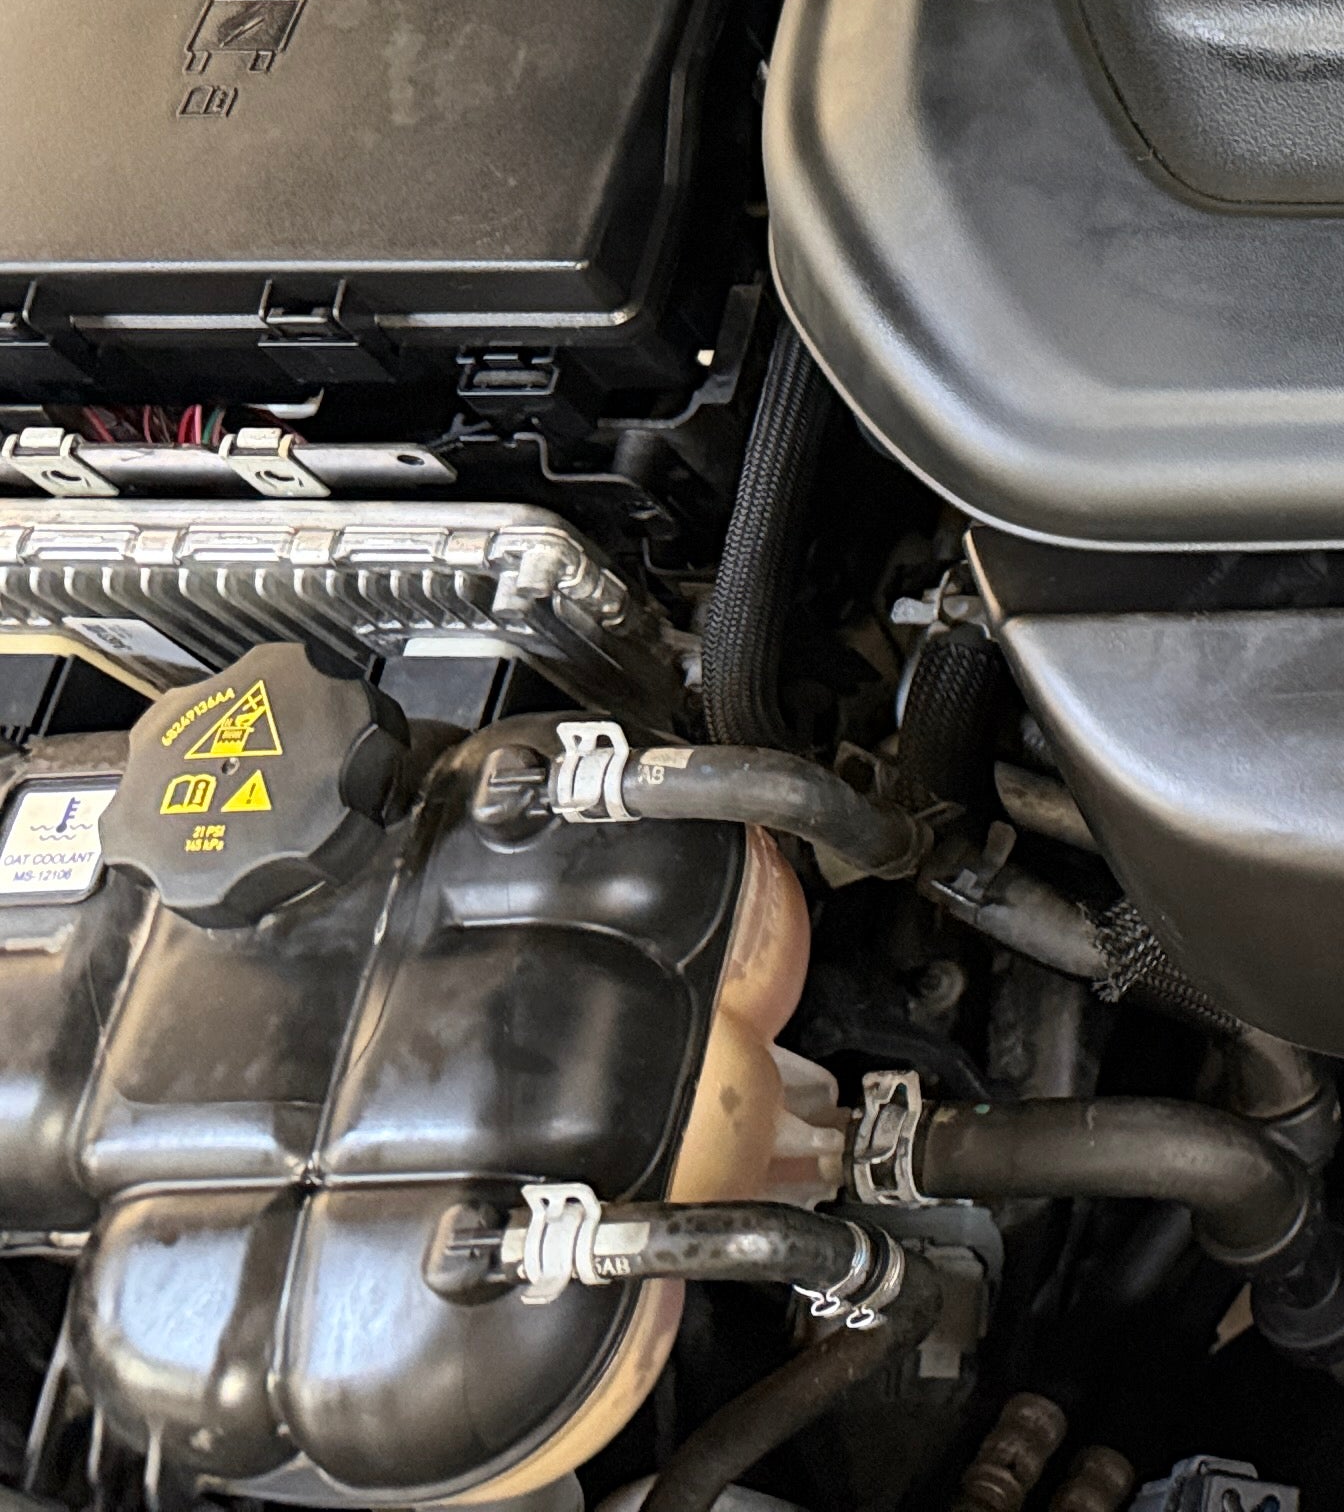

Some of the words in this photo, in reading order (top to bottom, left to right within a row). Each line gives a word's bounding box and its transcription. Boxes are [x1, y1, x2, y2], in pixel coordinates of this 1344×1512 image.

[206, 824, 226, 838] PSI
[4, 854, 30, 866] OAT
[33, 851, 95, 865] COOLANT
